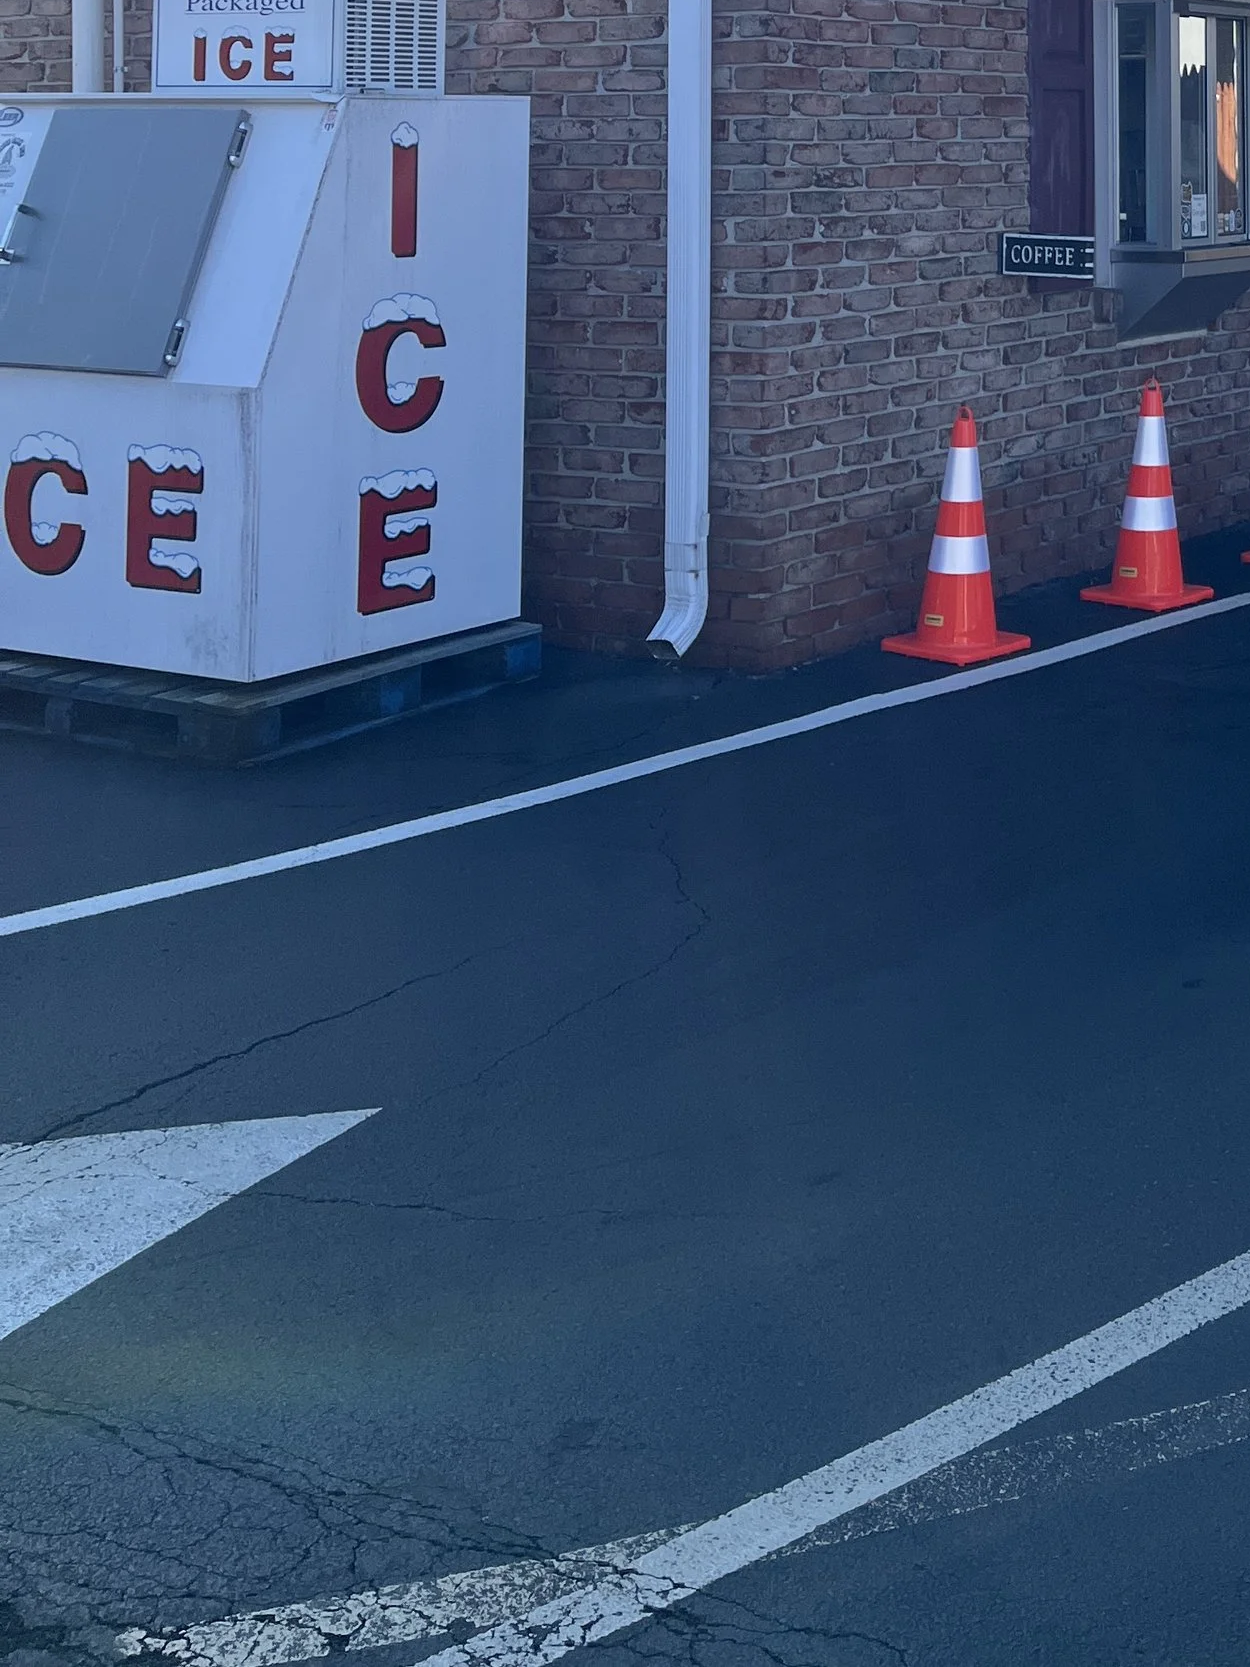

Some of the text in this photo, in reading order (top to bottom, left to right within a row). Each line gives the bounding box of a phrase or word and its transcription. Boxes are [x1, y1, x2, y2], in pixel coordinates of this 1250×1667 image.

[193, 25, 296, 82] ICE
[1011, 244, 1075, 266] COFFEE
[355, 121, 447, 616] ICE
[4, 431, 205, 594] CE
